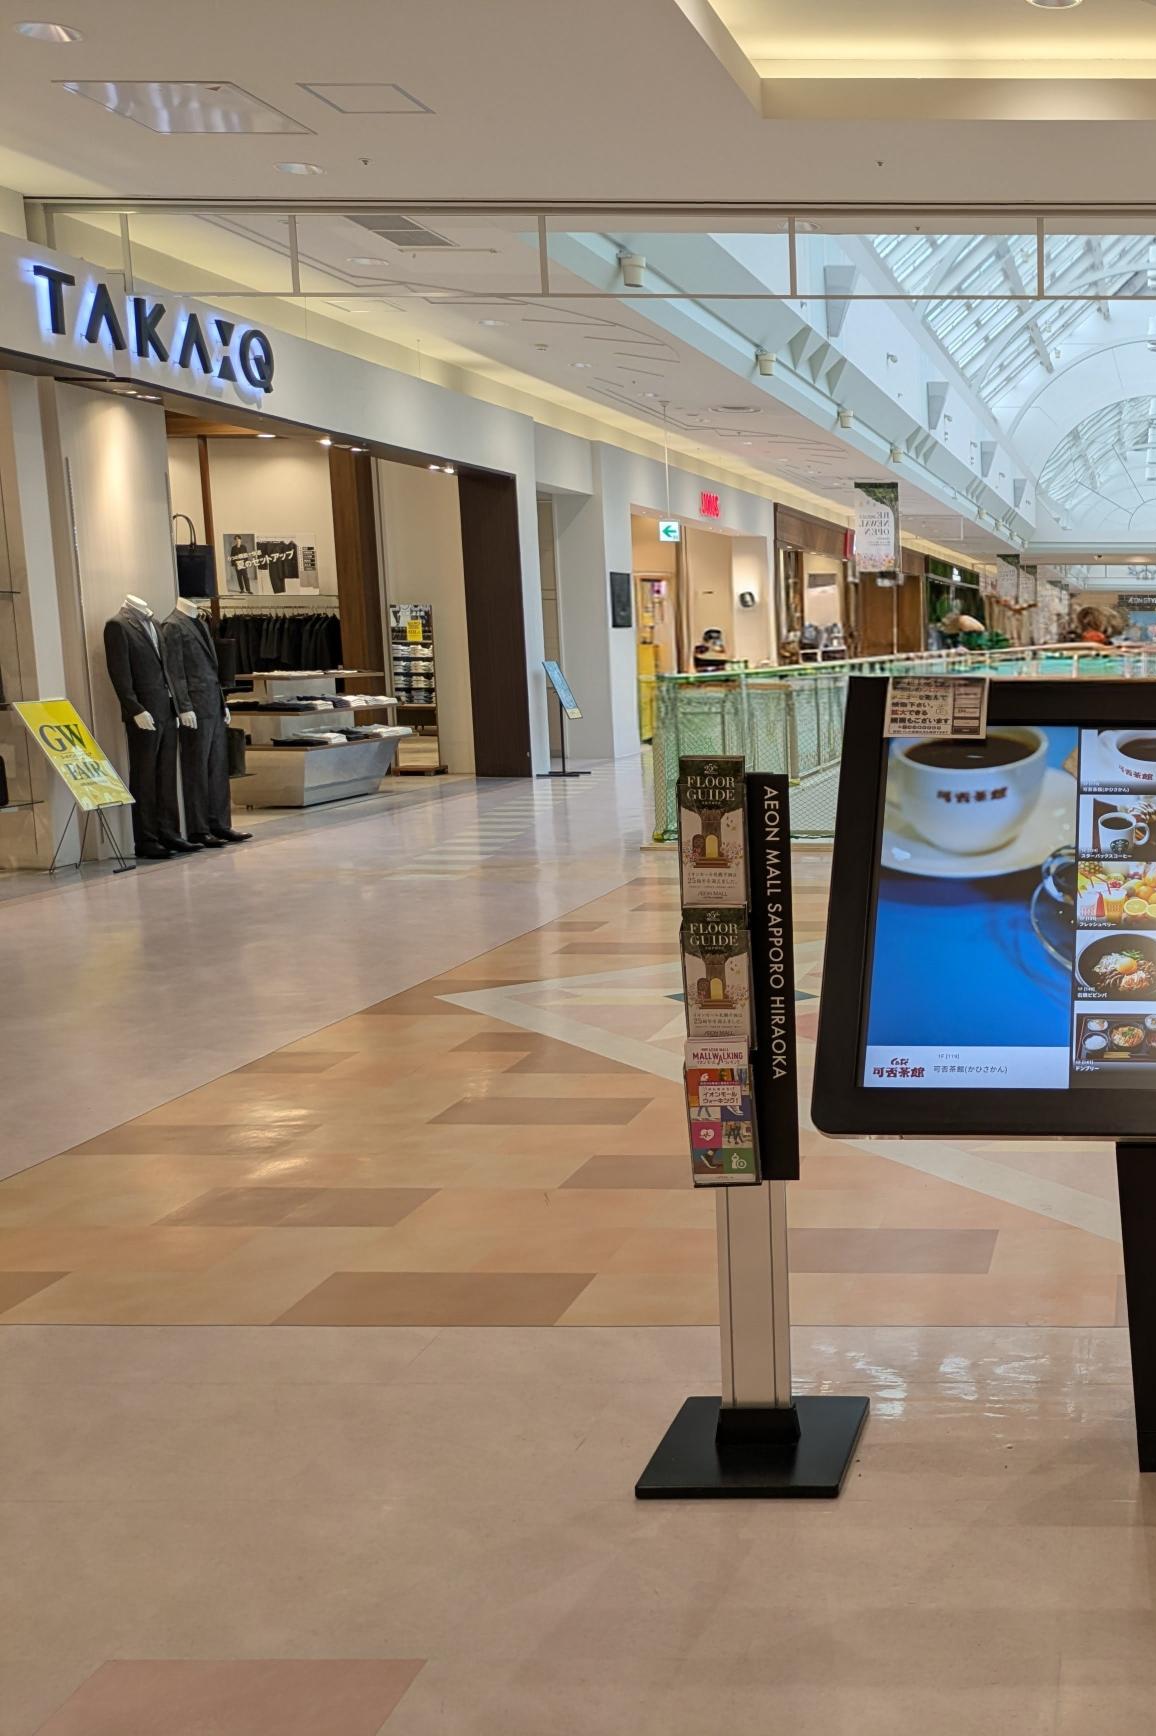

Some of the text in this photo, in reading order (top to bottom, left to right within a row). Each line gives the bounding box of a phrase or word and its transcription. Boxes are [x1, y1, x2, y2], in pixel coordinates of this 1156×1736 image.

[38, 723, 88, 752] GW
[63, 760, 111, 781] FAIR
[686, 776, 736, 788] FLOOR
[686, 789, 736, 801] GUIDE
[690, 923, 739, 934] FLOOR
[763, 785, 788, 1080] AEON MALL SAPPORO HIRAOKA
[690, 935, 739, 946] GUIDE
[692, 1052, 744, 1064] MALLWALKING
[872, 1066, 926, 1079] 可否茶館
